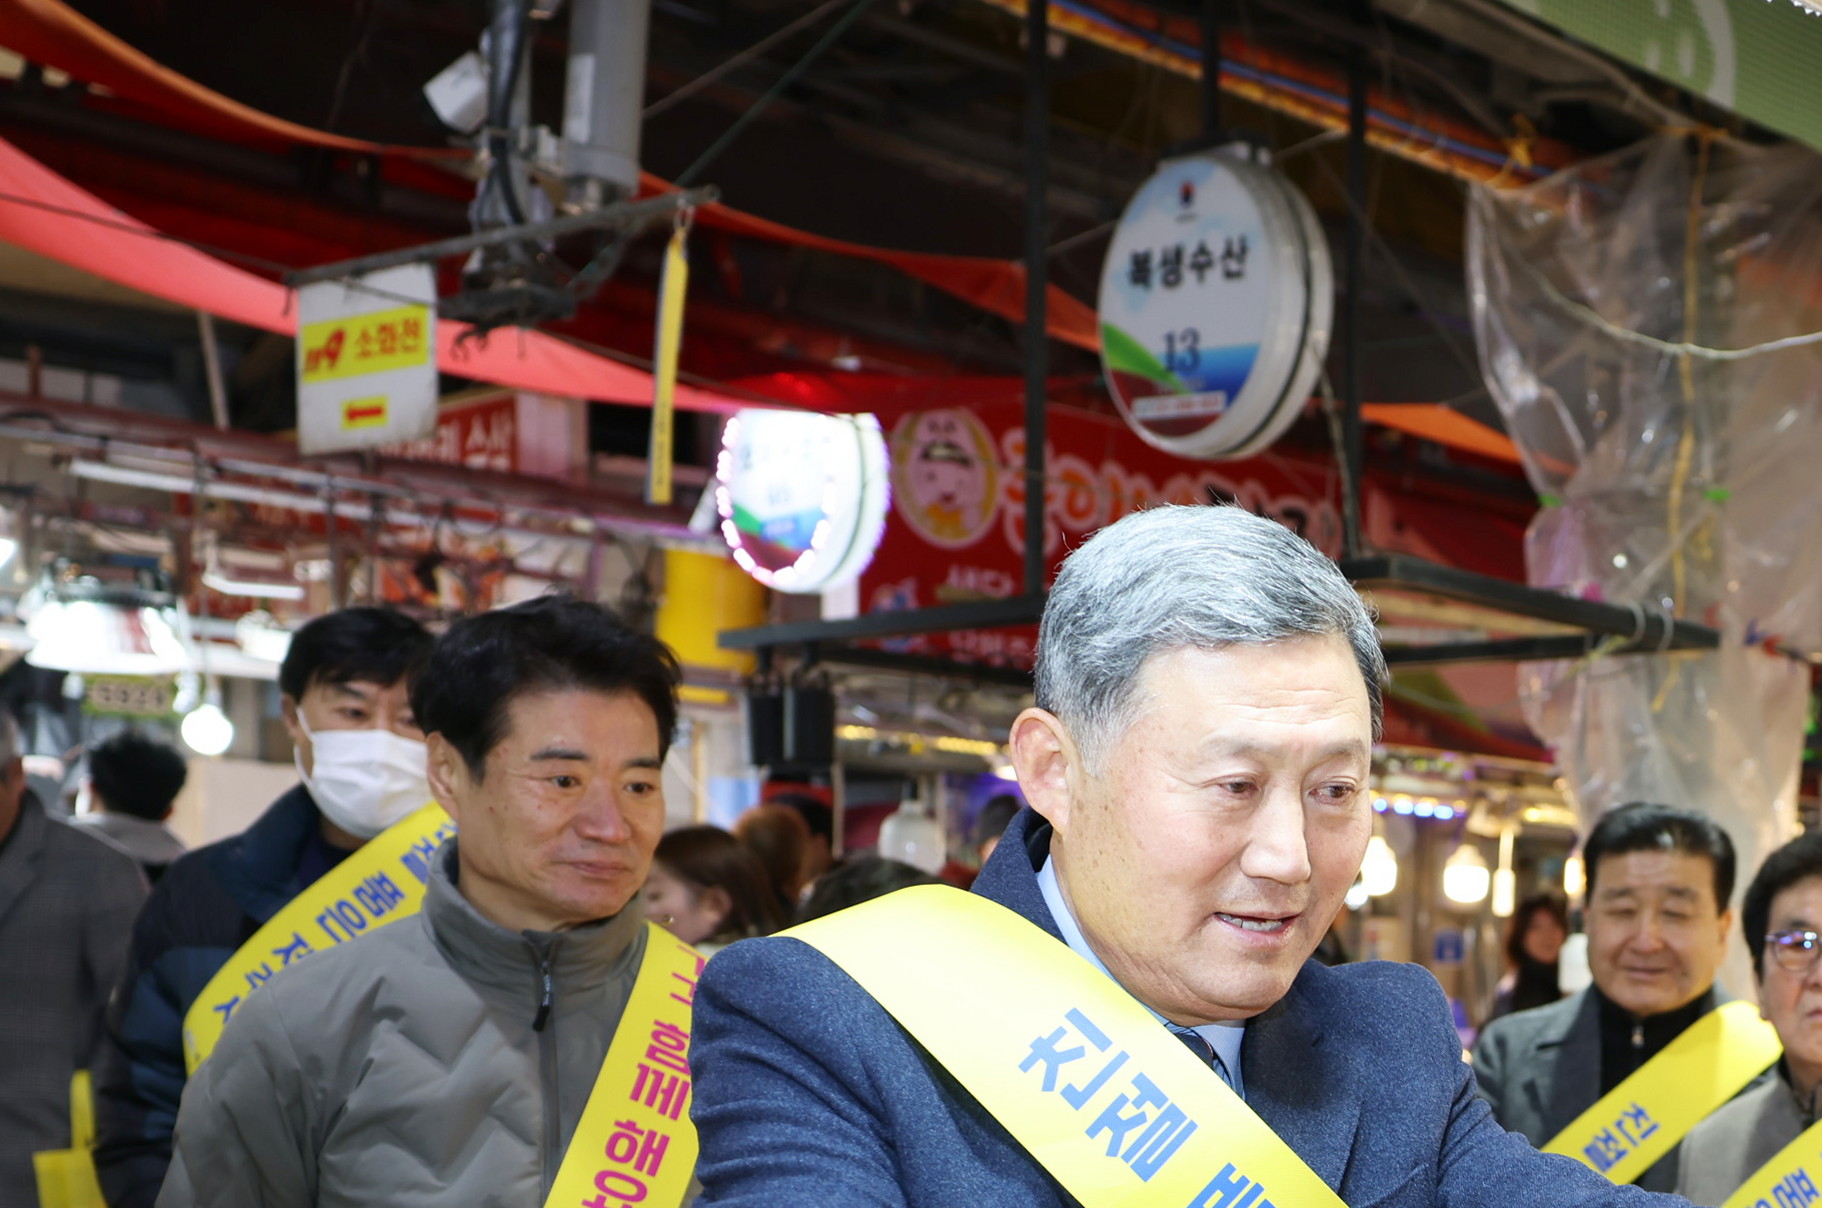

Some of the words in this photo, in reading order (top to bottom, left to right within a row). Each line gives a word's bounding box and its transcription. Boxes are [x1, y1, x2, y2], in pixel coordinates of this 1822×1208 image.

[1163, 327, 1200, 374] 13
[1019, 1007, 1197, 1182] 친절
[1582, 1101, 1661, 1173] 친절
